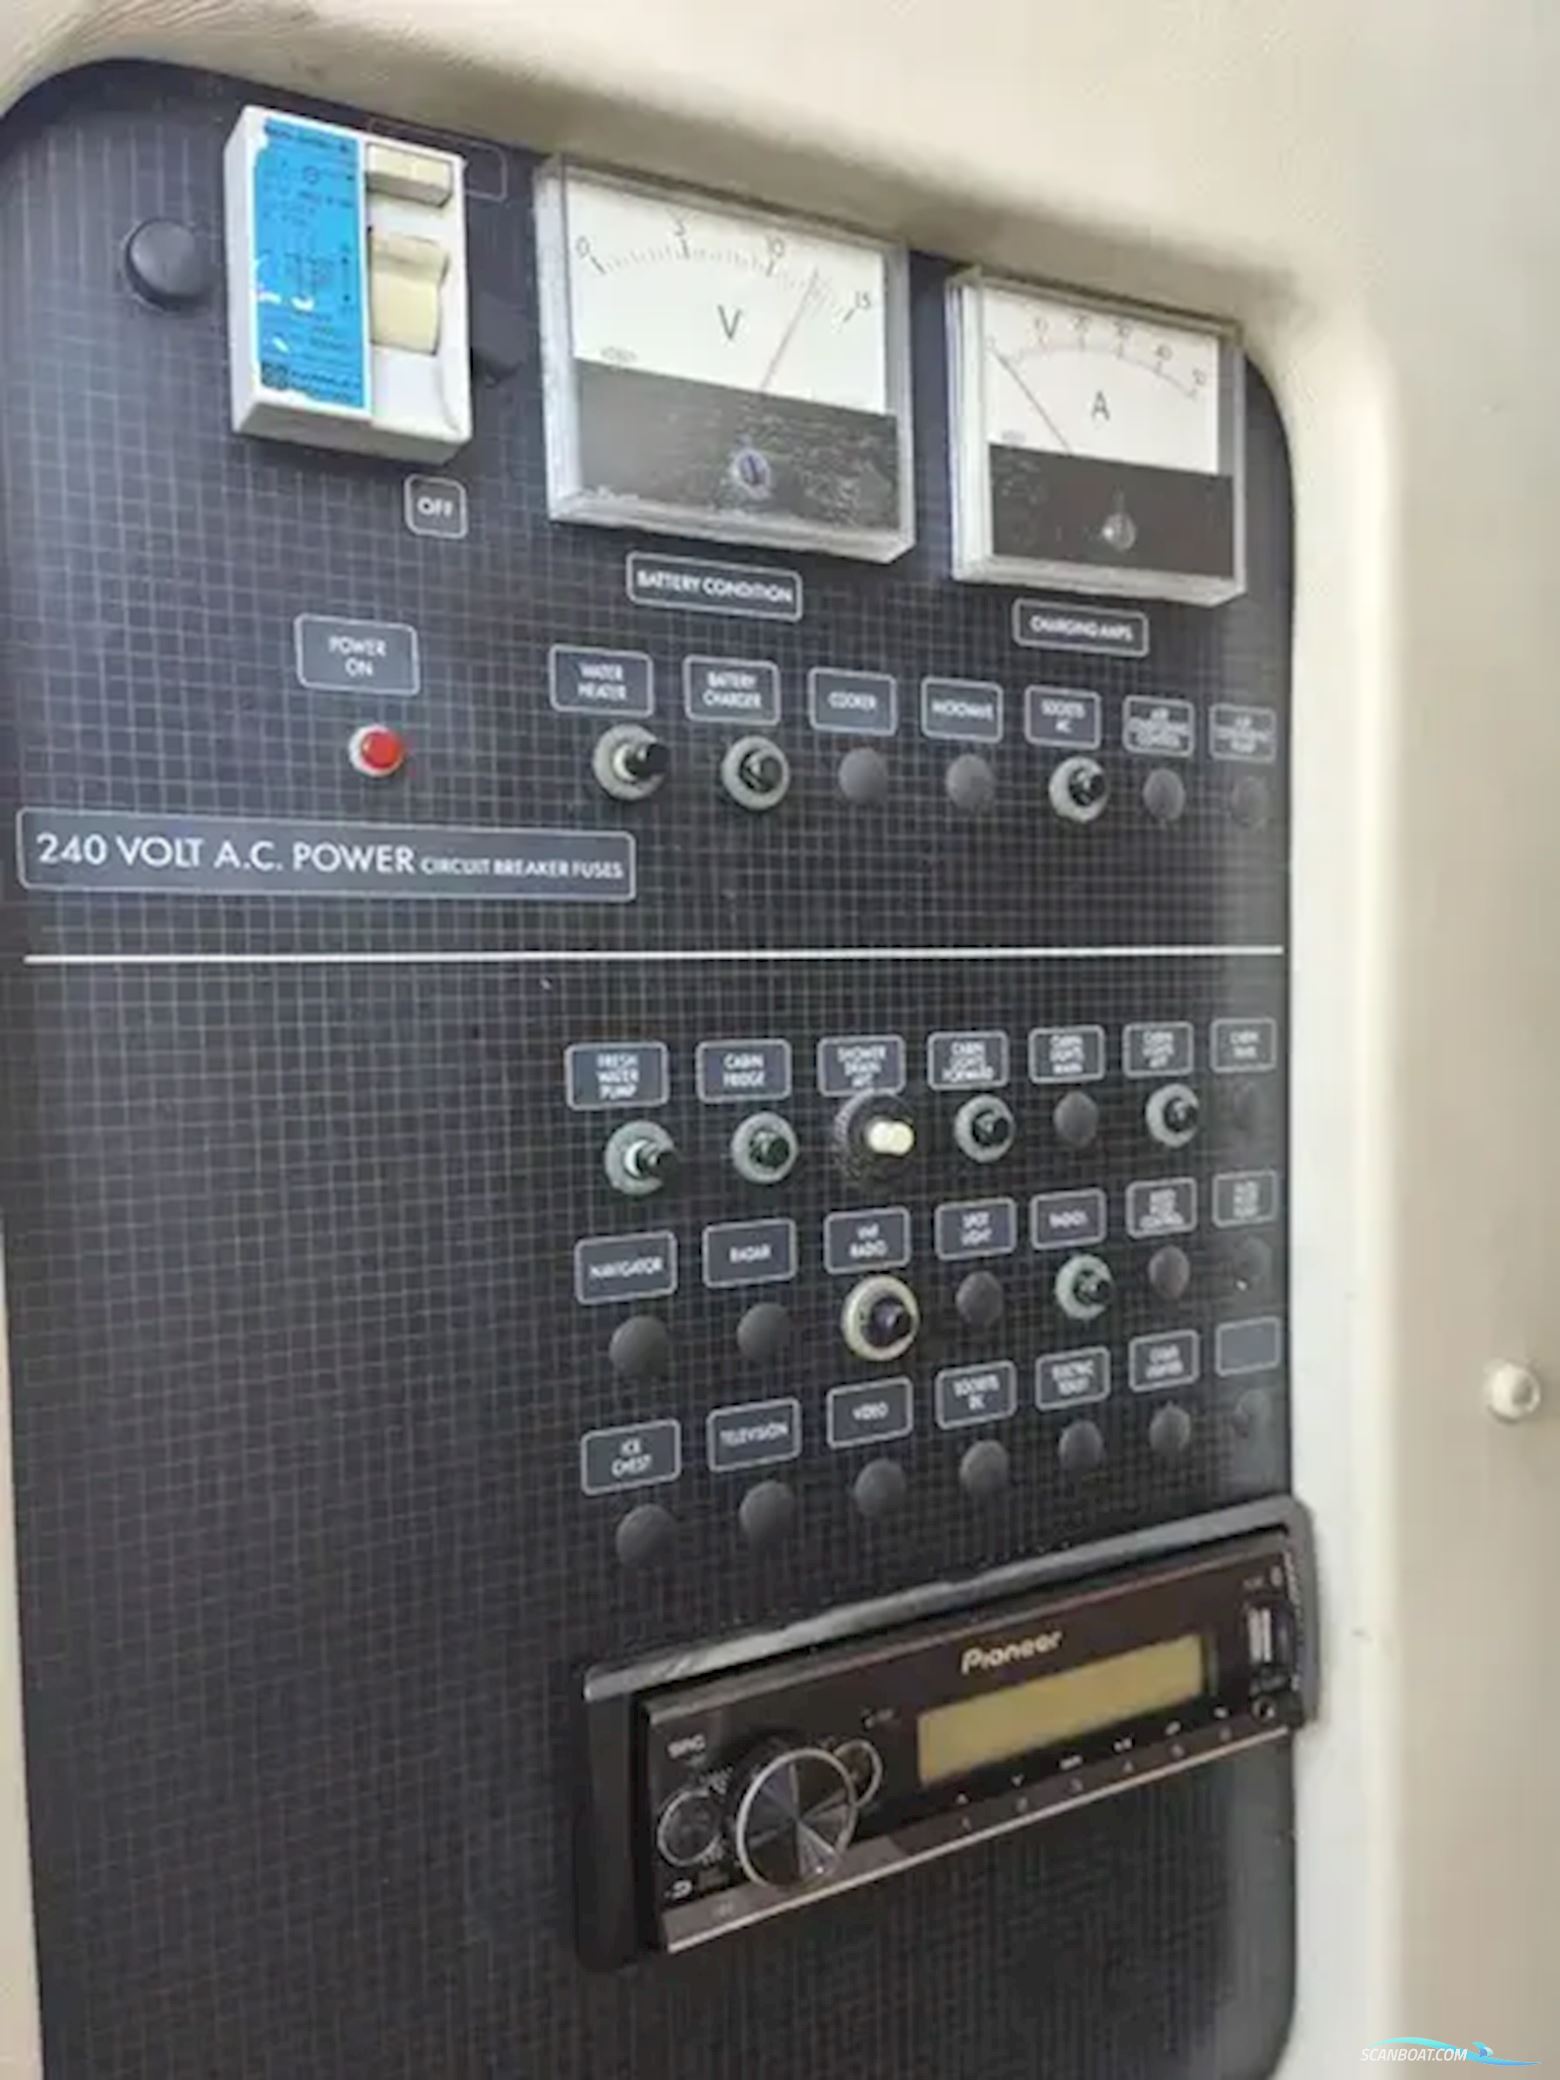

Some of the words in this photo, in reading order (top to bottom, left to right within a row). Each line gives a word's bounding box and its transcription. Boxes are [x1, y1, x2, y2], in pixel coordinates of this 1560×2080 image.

[716, 303, 743, 341] V
[1091, 389, 1112, 422] A
[417, 497, 455, 519] OFF
[636, 570, 700, 592] BATTERY
[702, 576, 794, 604] CONDITION
[328, 636, 387, 658] POWER
[344, 658, 374, 678] ON
[702, 690, 763, 711] CHARGER
[36, 833, 108, 866] 240
[115, 836, 205, 869] VOLT
[212, 840, 284, 873] A.C.
[292, 842, 417, 875] POWER
[420, 857, 491, 876] CIRCUIT
[492, 858, 570, 877] BREAKER
[571, 860, 625, 879] FUSES
[589, 1256, 663, 1280] NAVIGATOR
[719, 1421, 789, 1446] TELEVISION
[961, 1630, 1063, 1675] Pioneer
